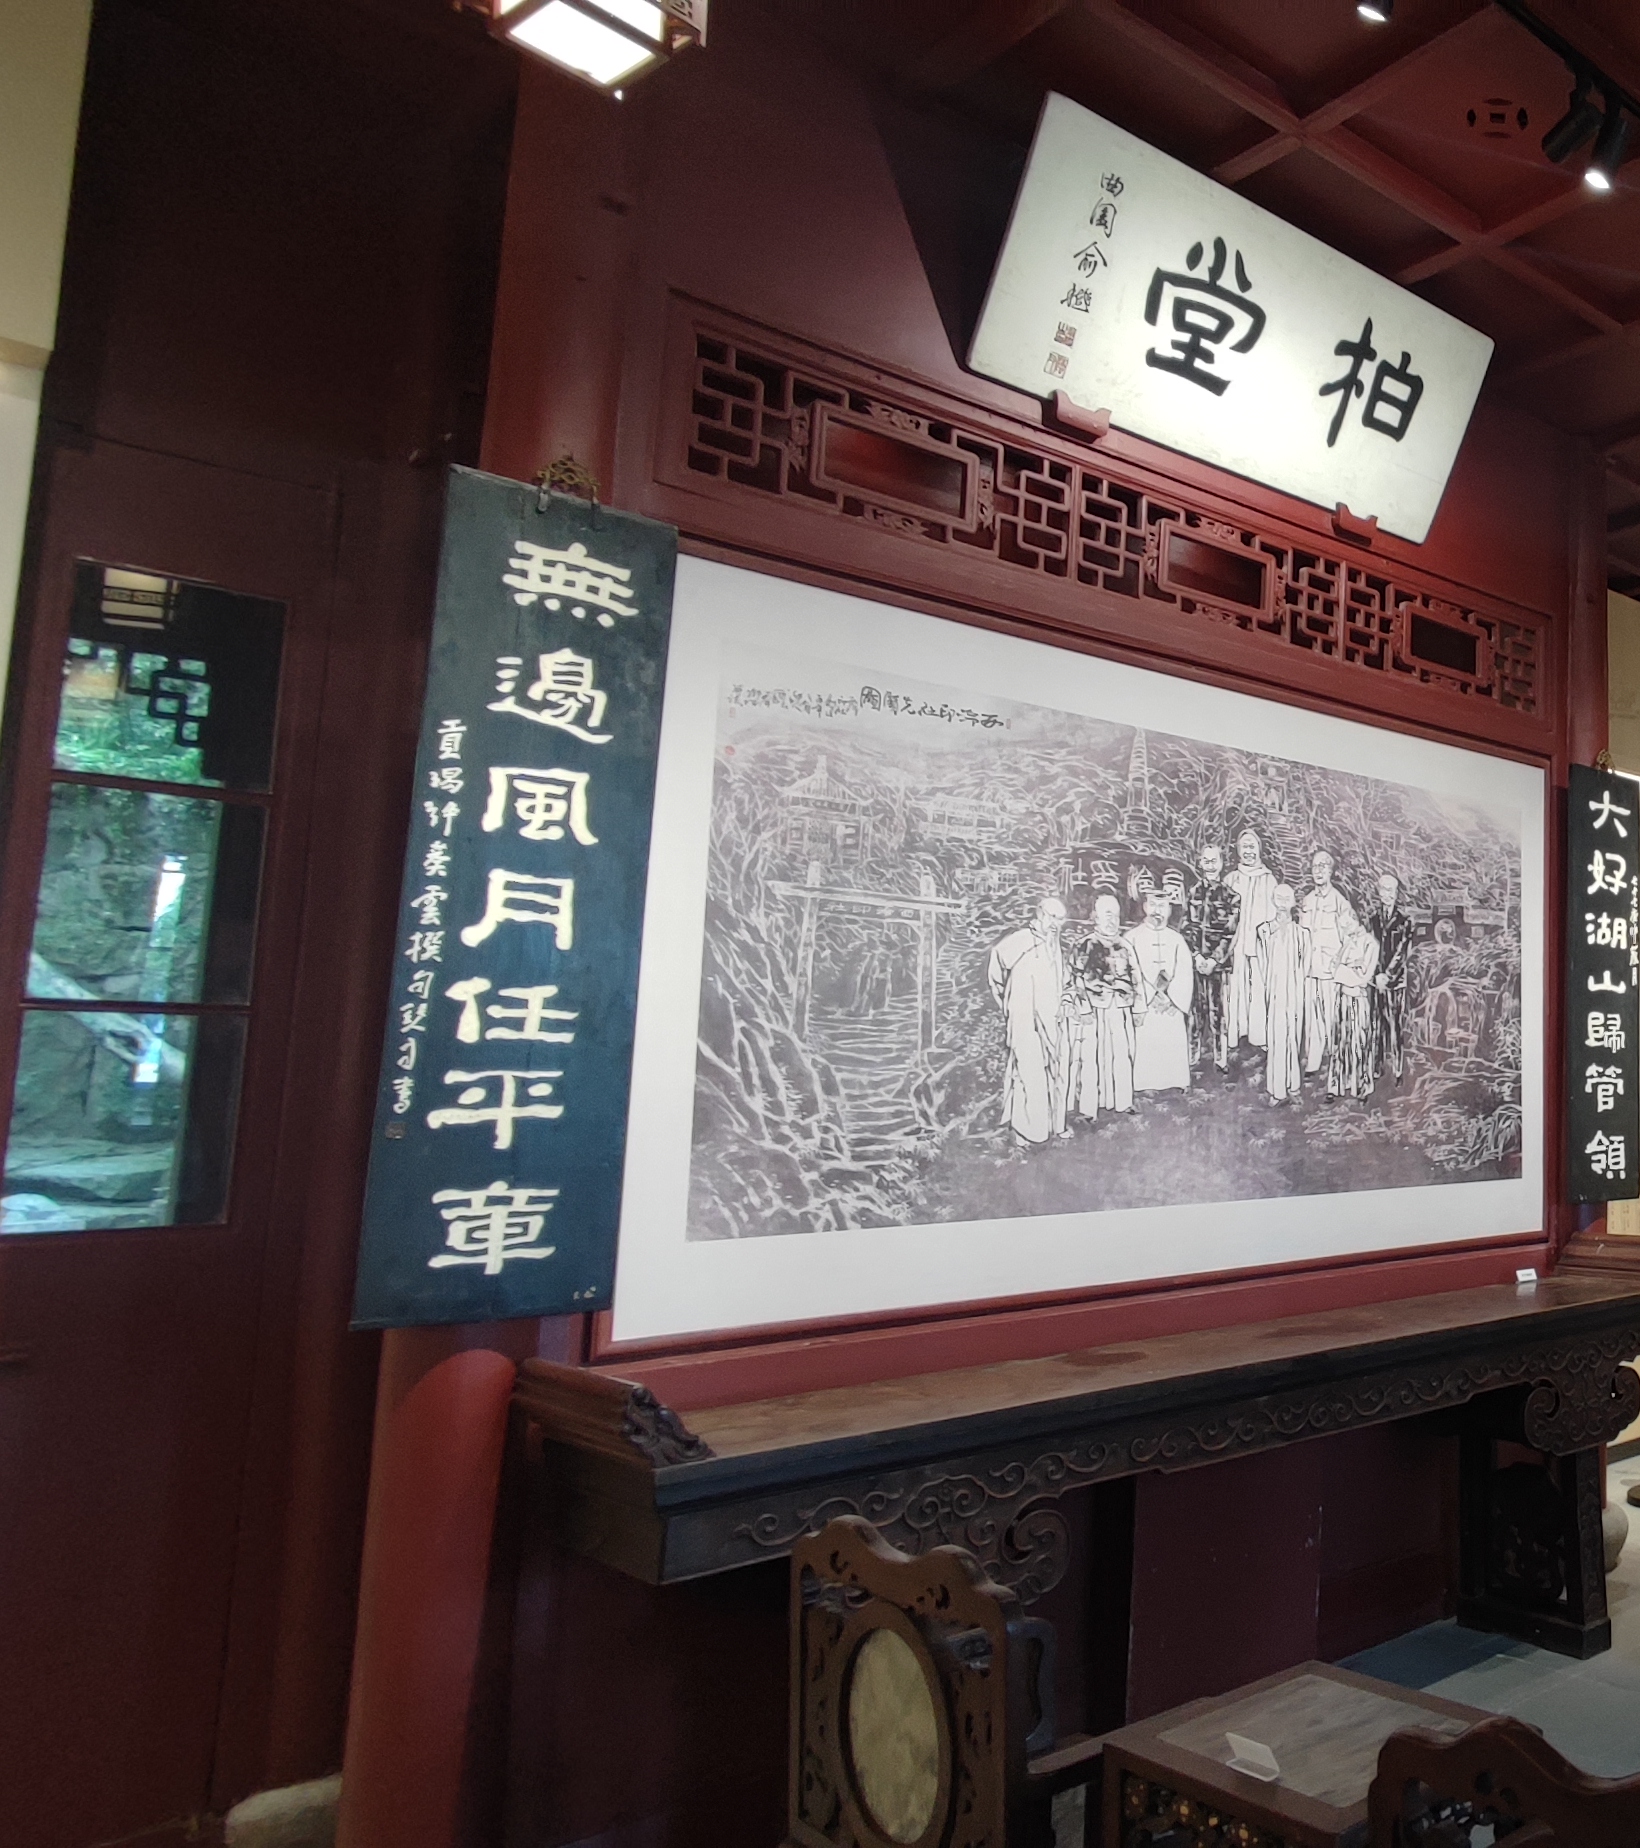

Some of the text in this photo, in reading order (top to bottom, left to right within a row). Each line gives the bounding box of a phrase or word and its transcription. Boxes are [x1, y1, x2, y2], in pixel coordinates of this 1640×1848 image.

[1144, 236, 1424, 448] 柏堂
[426, 541, 640, 1276] 無邊風月任平章
[1584, 790, 1632, 1181] 大好湖山歸管領
